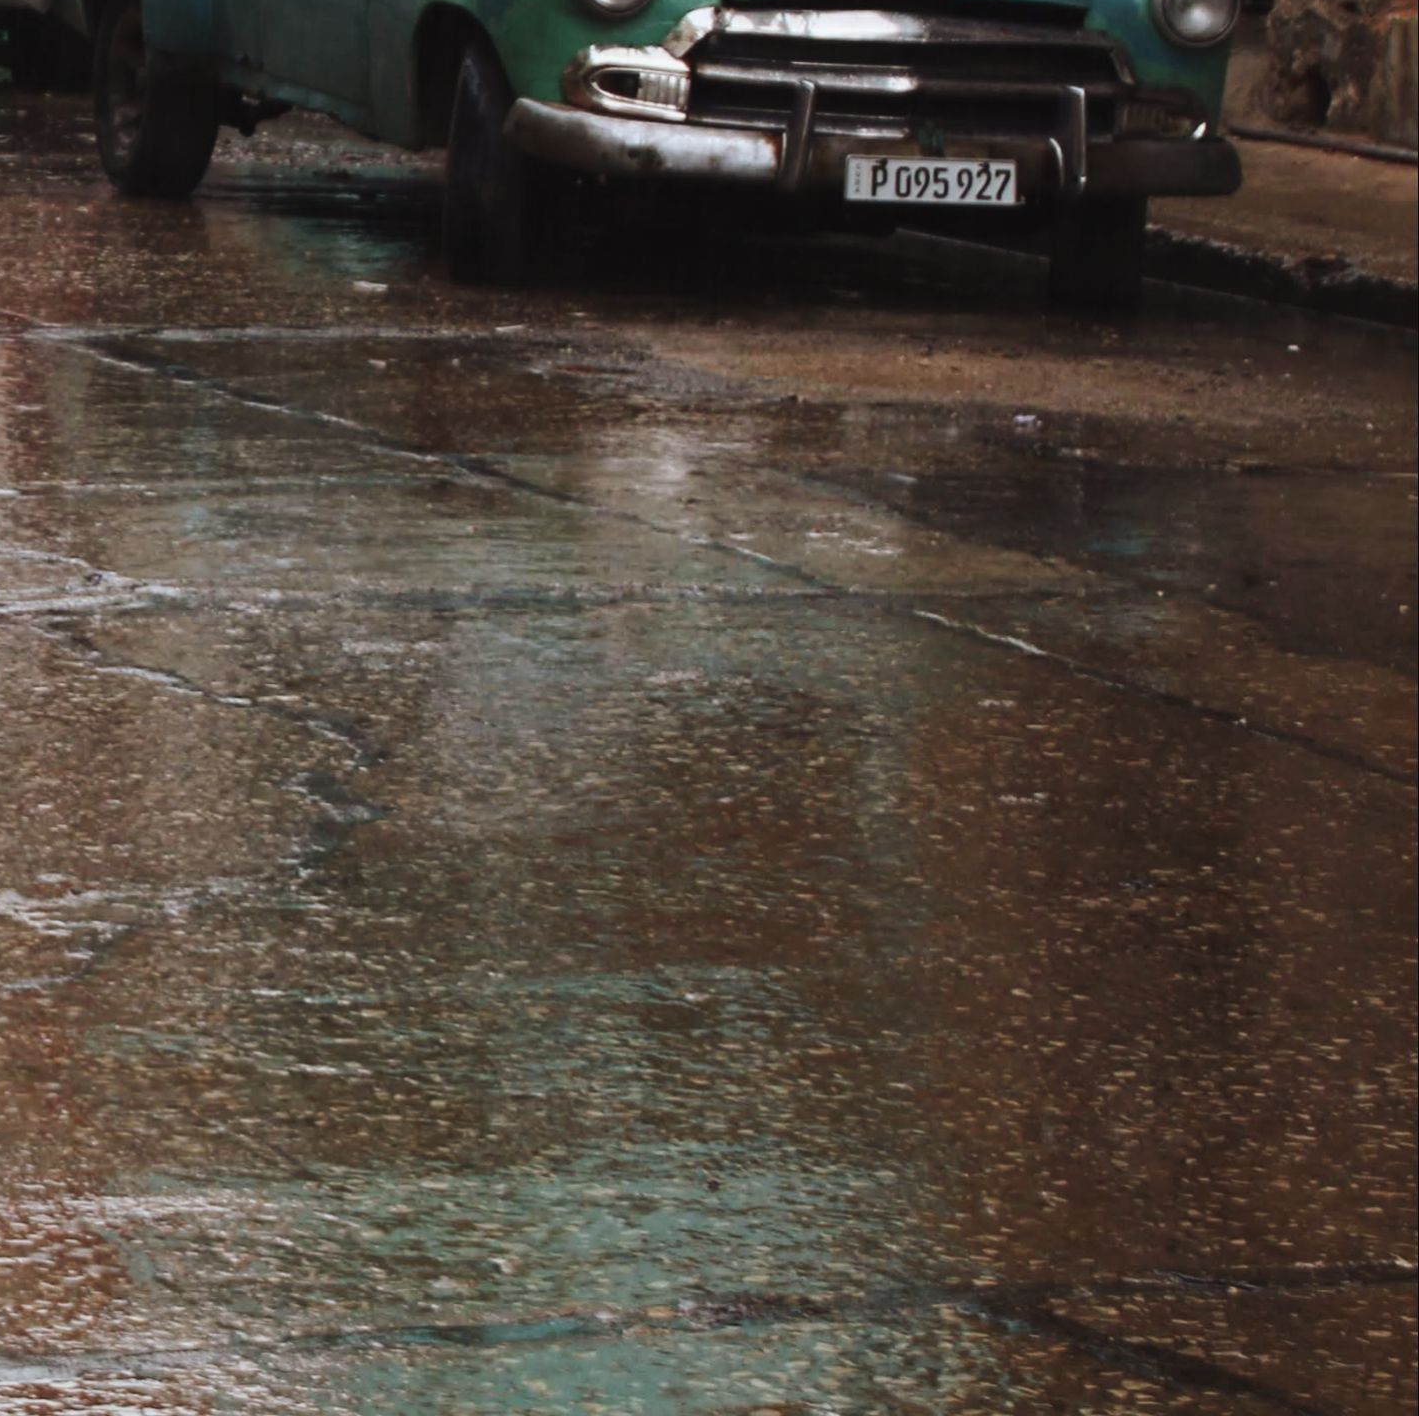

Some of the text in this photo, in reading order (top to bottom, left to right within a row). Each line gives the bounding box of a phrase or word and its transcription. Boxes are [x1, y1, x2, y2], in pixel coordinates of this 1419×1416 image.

[871, 164, 1011, 201] P 095 927
